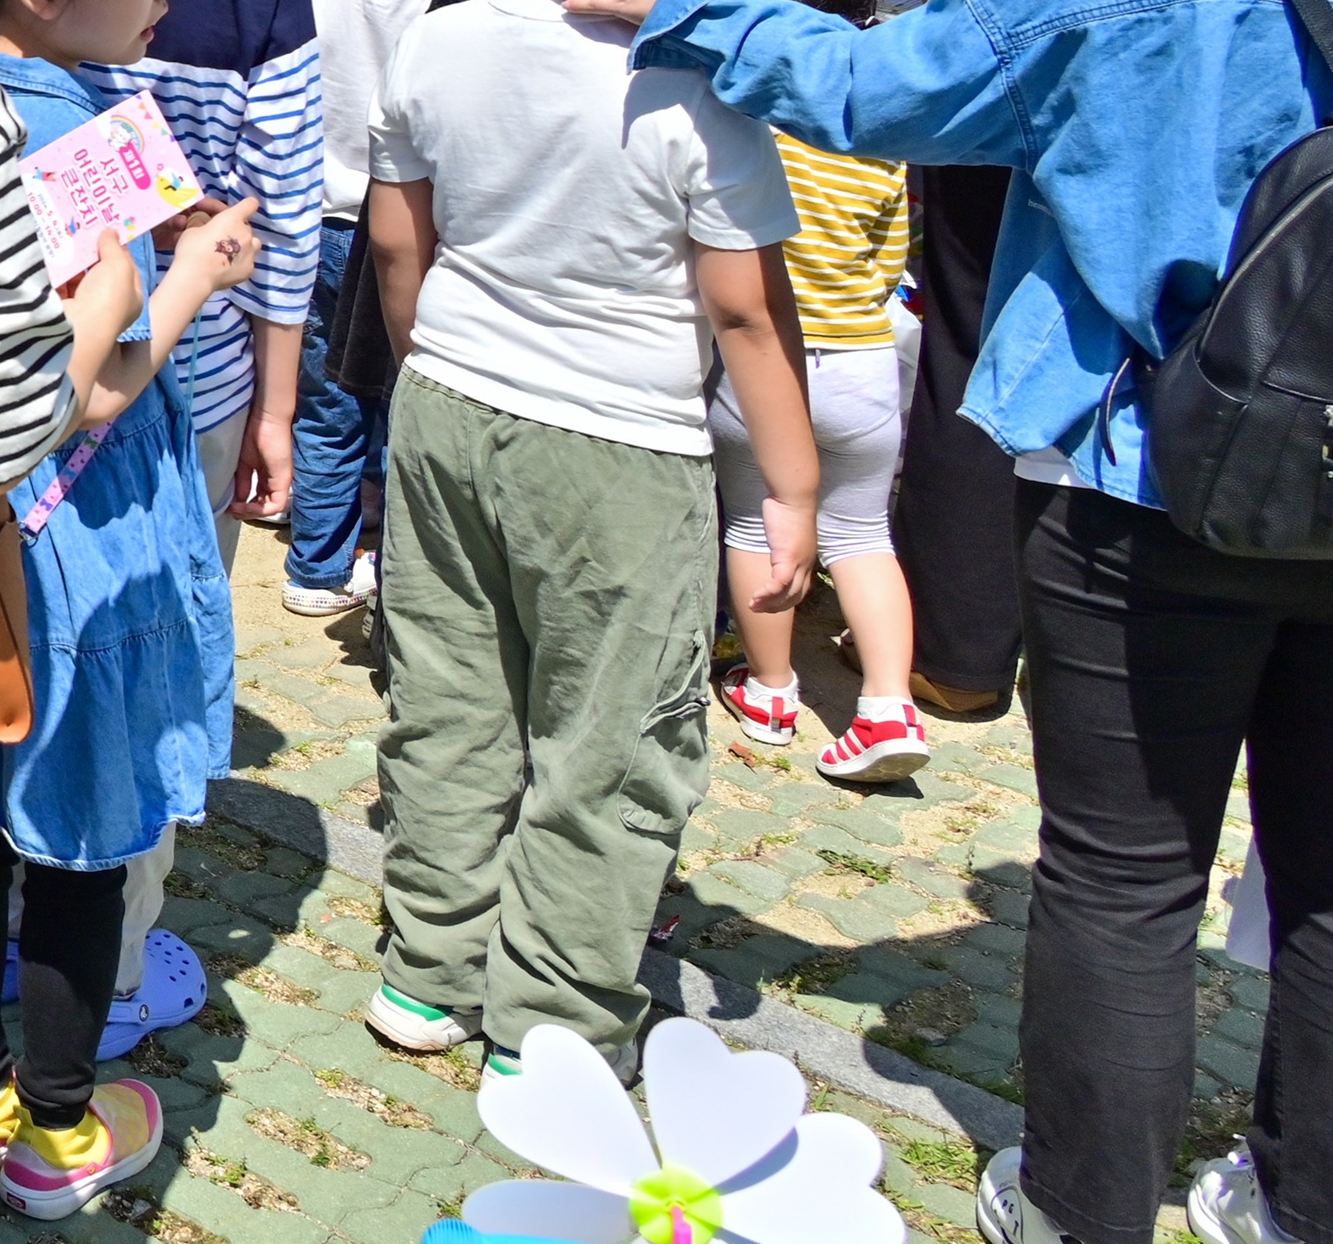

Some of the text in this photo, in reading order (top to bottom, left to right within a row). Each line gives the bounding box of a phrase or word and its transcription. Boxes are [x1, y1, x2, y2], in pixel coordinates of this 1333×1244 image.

[61, 168, 98, 225] 큰잔치
[74, 148, 120, 224] 어린이날
[100, 158, 129, 194] 서구
